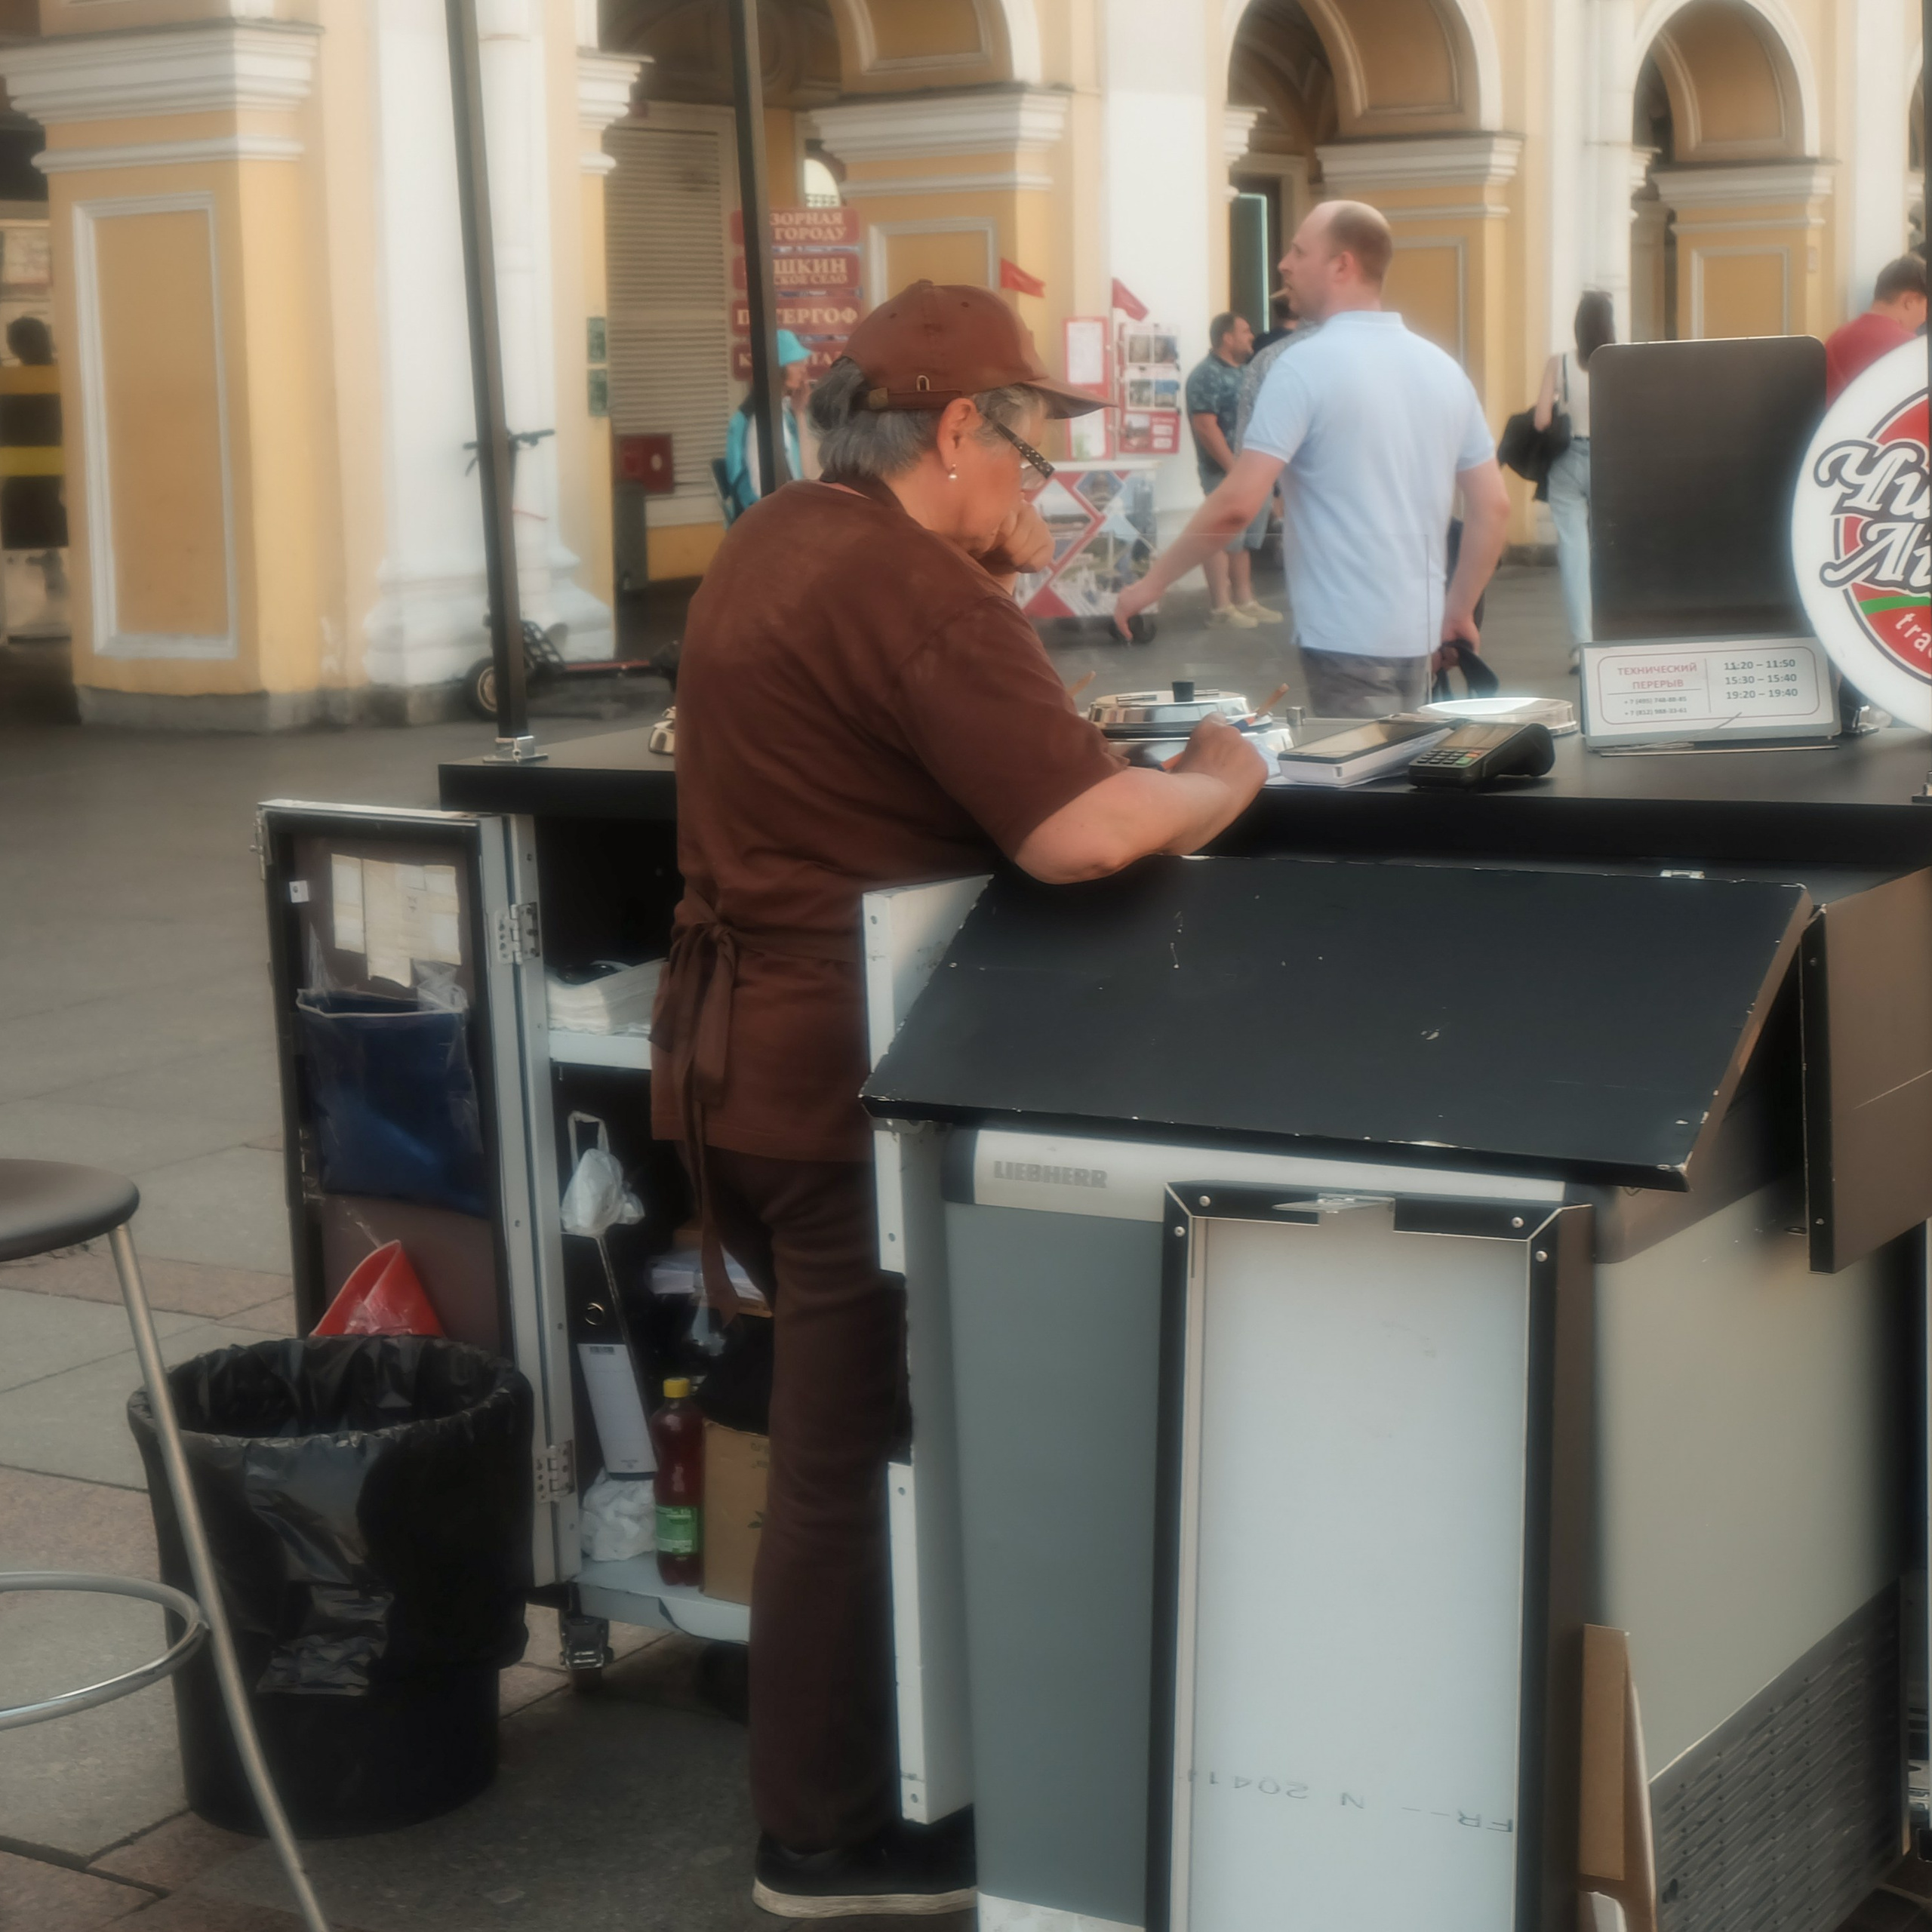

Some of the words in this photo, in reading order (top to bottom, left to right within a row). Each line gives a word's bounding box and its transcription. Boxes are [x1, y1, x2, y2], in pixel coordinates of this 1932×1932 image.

[774, 226, 848, 241] ГОРОДУ
[772, 257, 848, 274] ШКИН
[1895, 613, 1931, 659] tra
[1617, 663, 1697, 675] ТЕХНИЧЕСКИЙ
[1724, 661, 1754, 670] 11:20
[1766, 659, 1796, 668] 11:50
[1632, 679, 1684, 690] ПЕРЕРЫВ
[1725, 675, 1755, 685] 15:30
[1767, 673, 1797, 683] 15:40
[1727, 690, 1756, 700] 19:20
[1769, 688, 1798, 697] 19:40
[994, 1161, 1108, 1189] LIEBHERR
[1341, 1792, 1364, 1809] N
